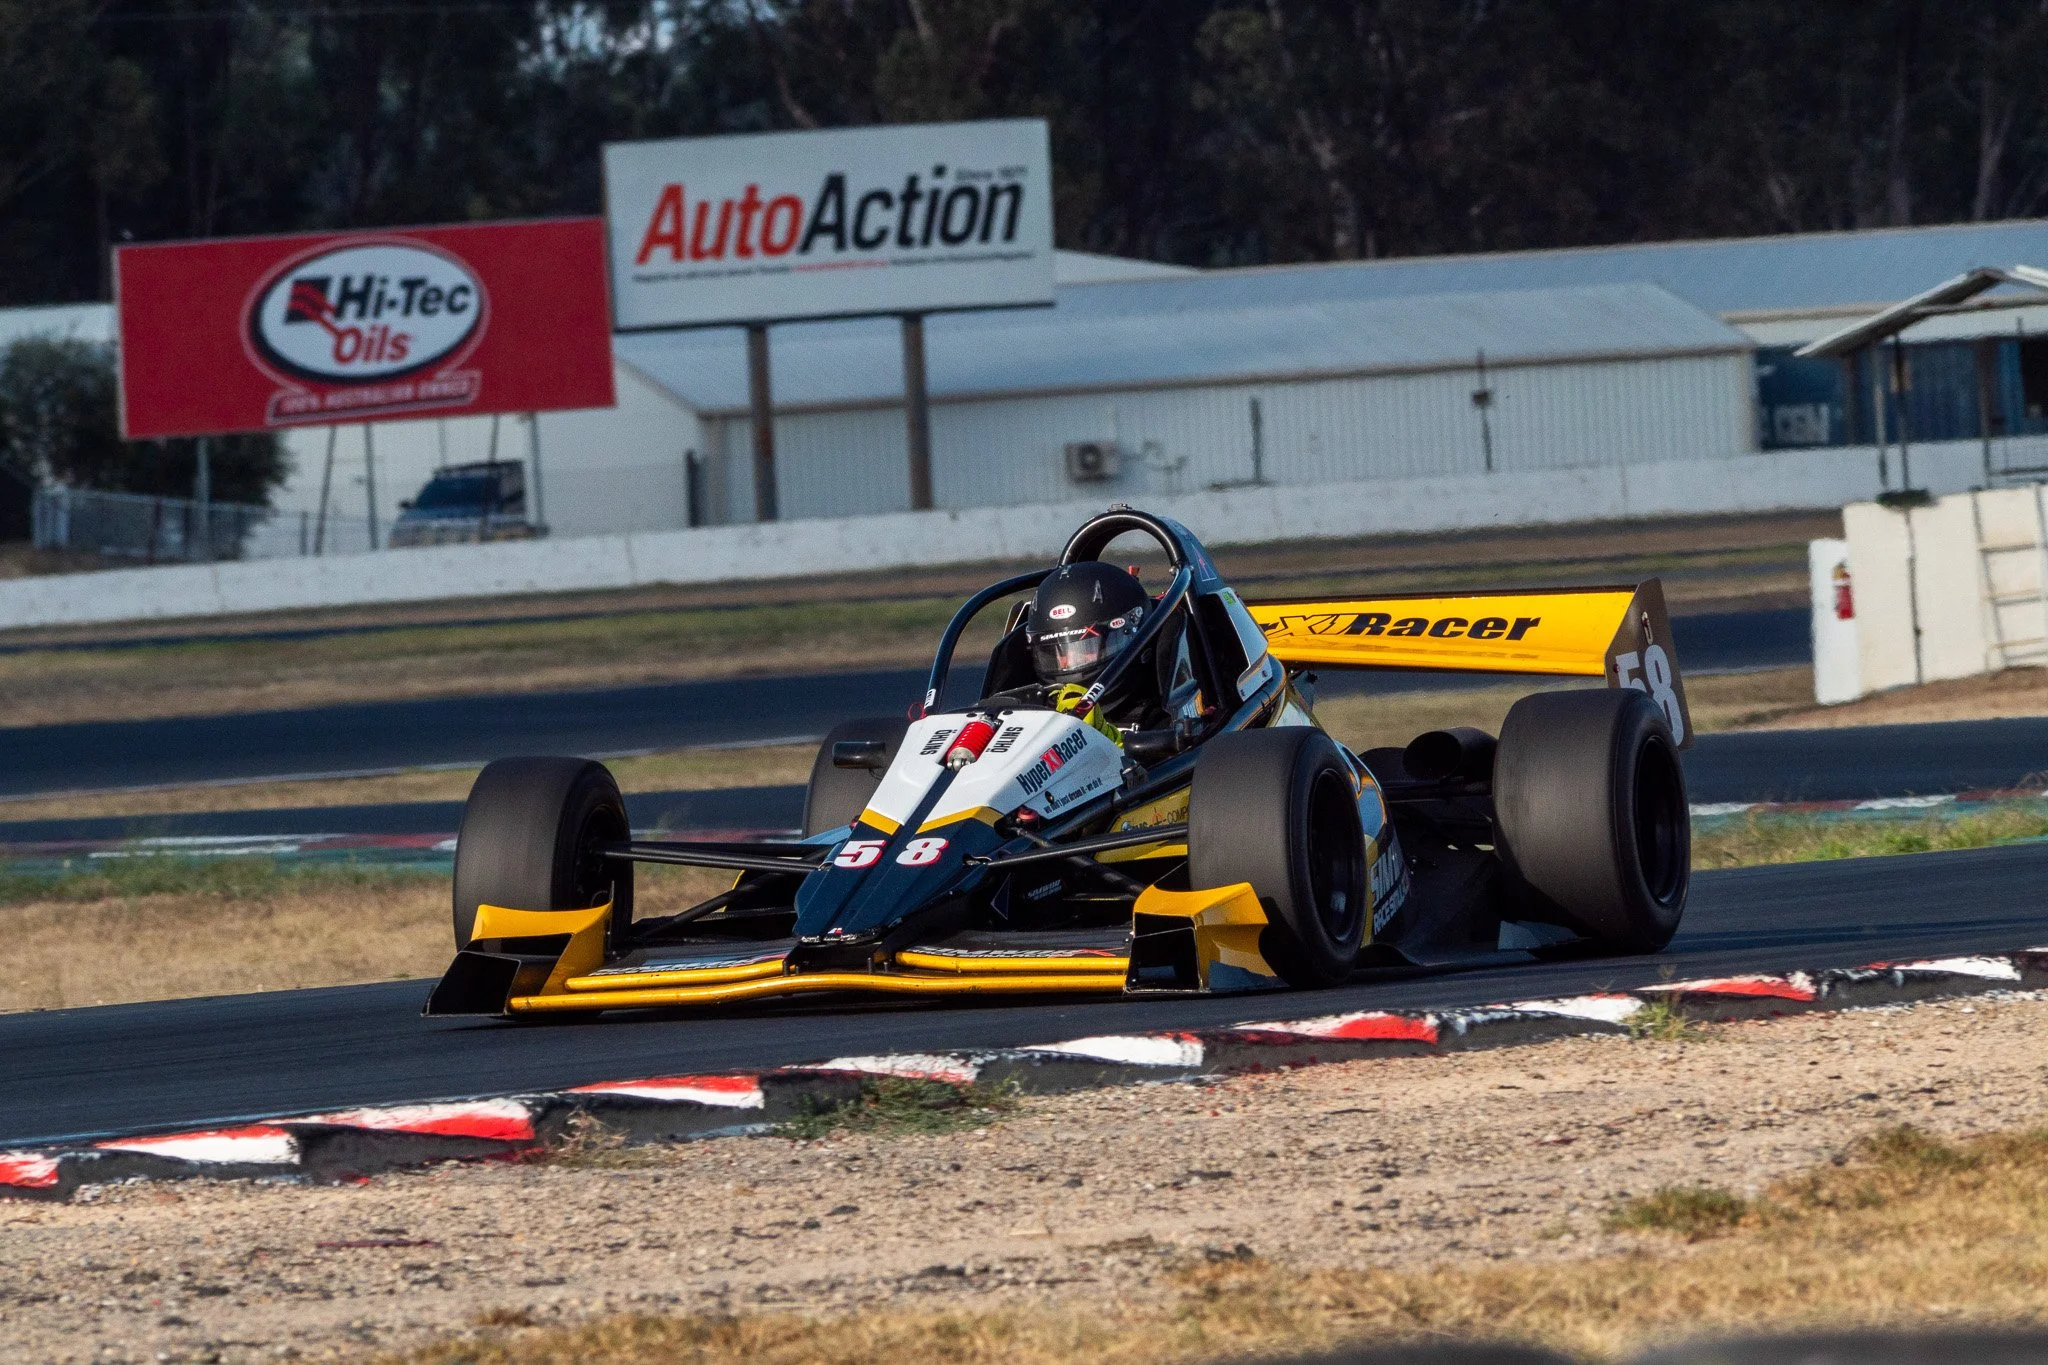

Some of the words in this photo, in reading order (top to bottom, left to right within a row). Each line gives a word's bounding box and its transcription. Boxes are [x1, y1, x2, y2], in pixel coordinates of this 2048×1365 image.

[635, 165, 1024, 265] AutoAction
[333, 274, 471, 321] Hi-Tec
[333, 324, 411, 364] Oils
[1052, 607, 1071, 616] BELL
[1112, 619, 1124, 627] BELL
